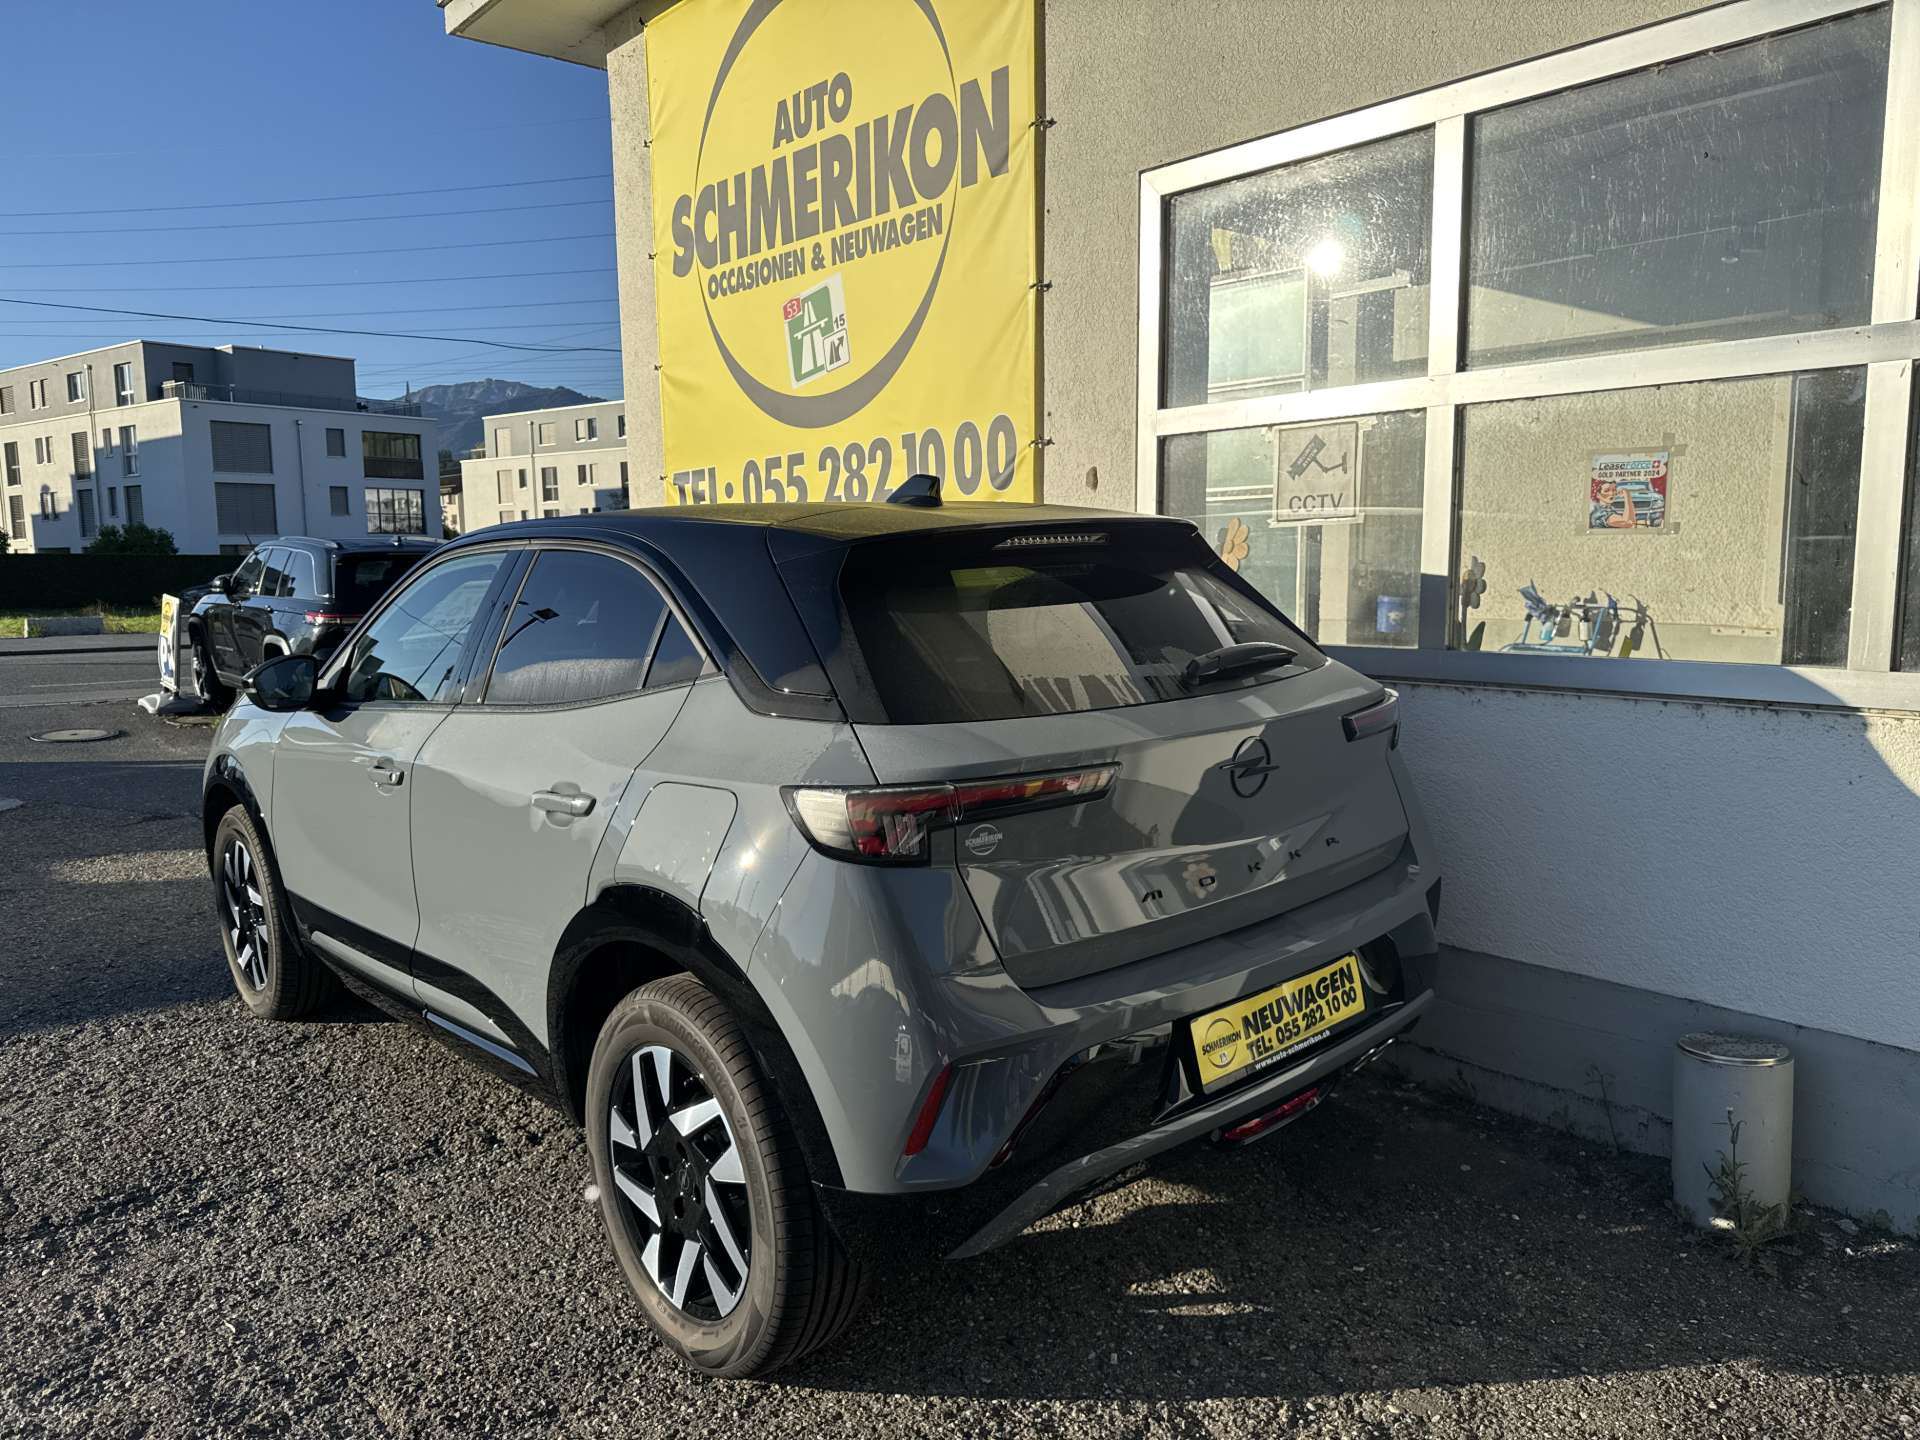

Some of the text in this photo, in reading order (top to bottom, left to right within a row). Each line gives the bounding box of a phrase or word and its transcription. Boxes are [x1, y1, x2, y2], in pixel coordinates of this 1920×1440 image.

[772, 71, 853, 150] AUTO
[671, 65, 1010, 278] SCHMERIKON
[707, 203, 944, 300] OCCASIONEN & NEUWAGEN
[786, 300, 799, 318] 53
[833, 313, 846, 329] 15
[742, 452, 809, 504] 055
[817, 437, 893, 504] 282
[1288, 493, 1344, 513] CCTV
[1615, 470, 1642, 478] PARTNER
[1643, 469, 1660, 477] 2024
[1241, 963, 1355, 1040] NEUWAGEN
[1247, 985, 1357, 1060] TEL: 055 282 10 00
[1202, 1029, 1242, 1056] SCHMERIKON
